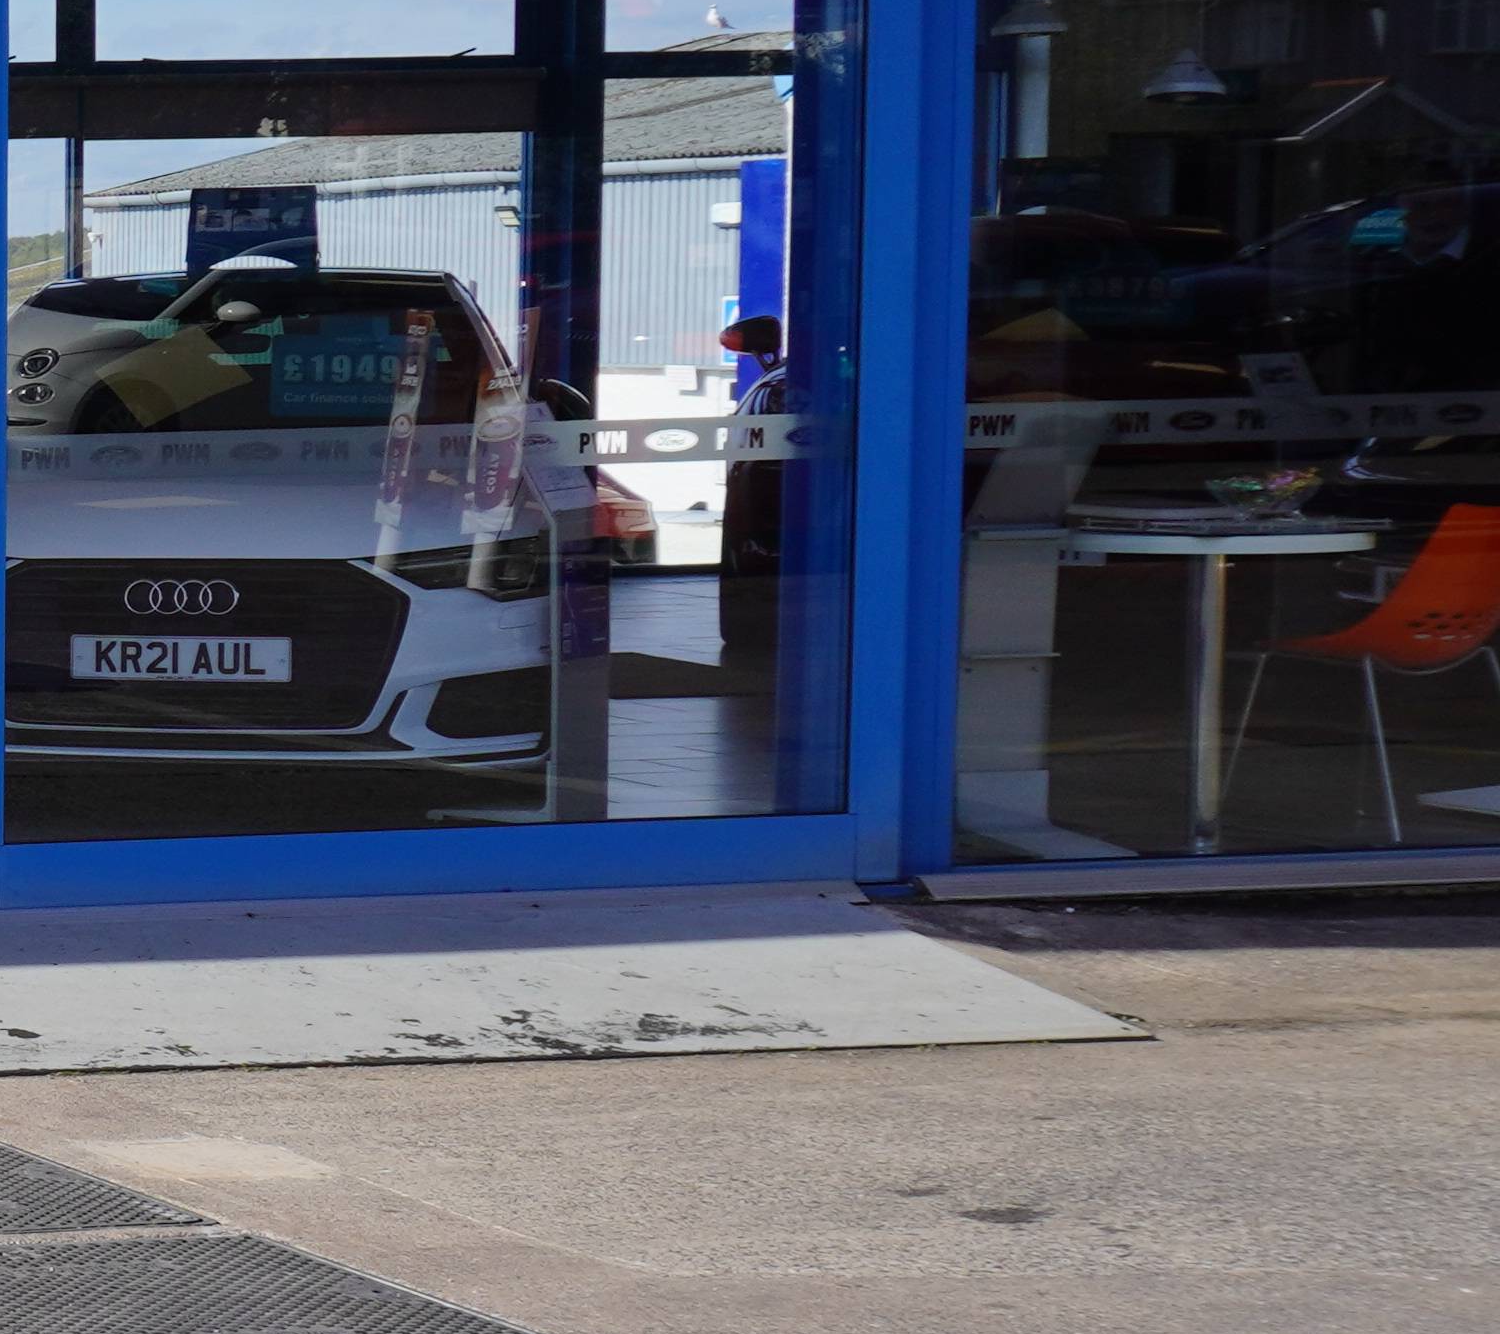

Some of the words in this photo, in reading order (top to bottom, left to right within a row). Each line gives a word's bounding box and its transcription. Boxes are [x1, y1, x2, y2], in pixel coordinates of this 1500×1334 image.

[283, 353, 402, 383] £1949
[284, 392, 308, 404] Car
[310, 392, 359, 404] finance
[969, 414, 1015, 436] PWM
[22, 446, 71, 469] PWM
[161, 442, 210, 465] PWM
[579, 429, 628, 454] PWM
[94, 640, 179, 674] KR21
[192, 642, 267, 676] AUL
